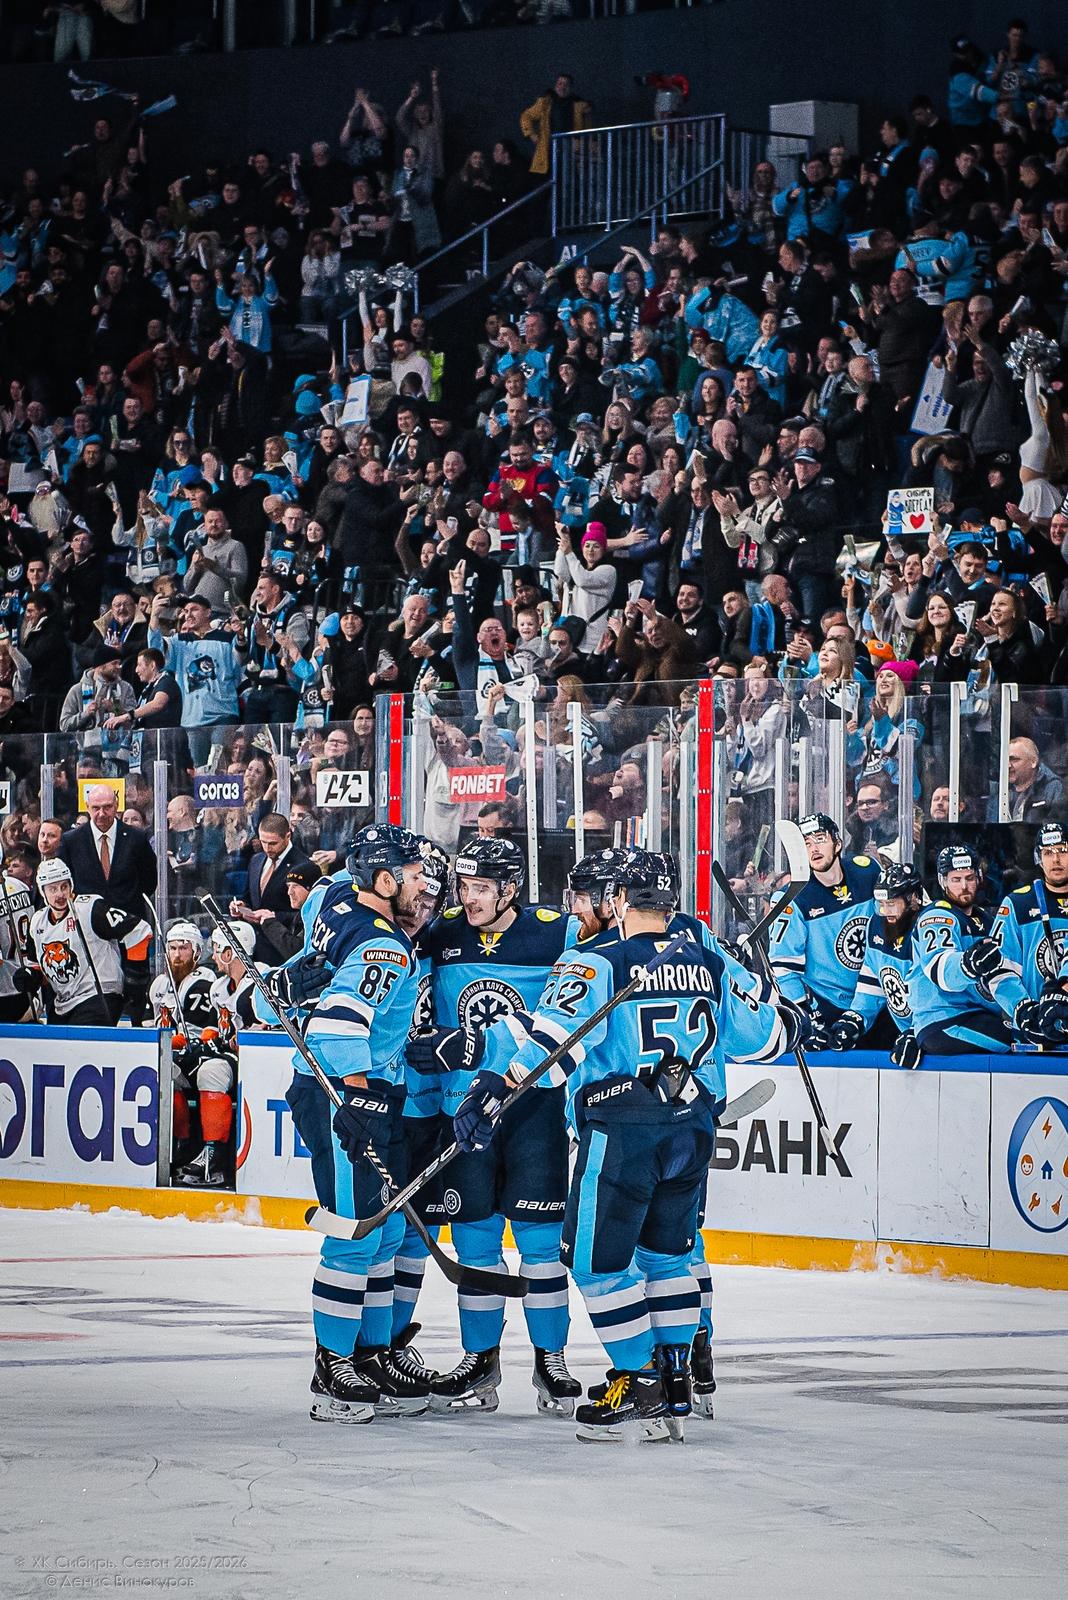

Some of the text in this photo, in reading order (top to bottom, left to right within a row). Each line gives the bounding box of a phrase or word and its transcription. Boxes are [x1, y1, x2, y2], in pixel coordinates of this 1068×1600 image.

[199, 782, 240, 800] согаз
[451, 774, 504, 795] FONBET
[657, 876, 671, 891] 52
[924, 927, 955, 953] 22
[366, 950, 402, 963] WINLINE
[358, 964, 401, 1005] 85
[486, 981, 505, 992] КЛУБ
[636, 997, 718, 1078] 52
[709, 1119, 853, 1178] БАНК
